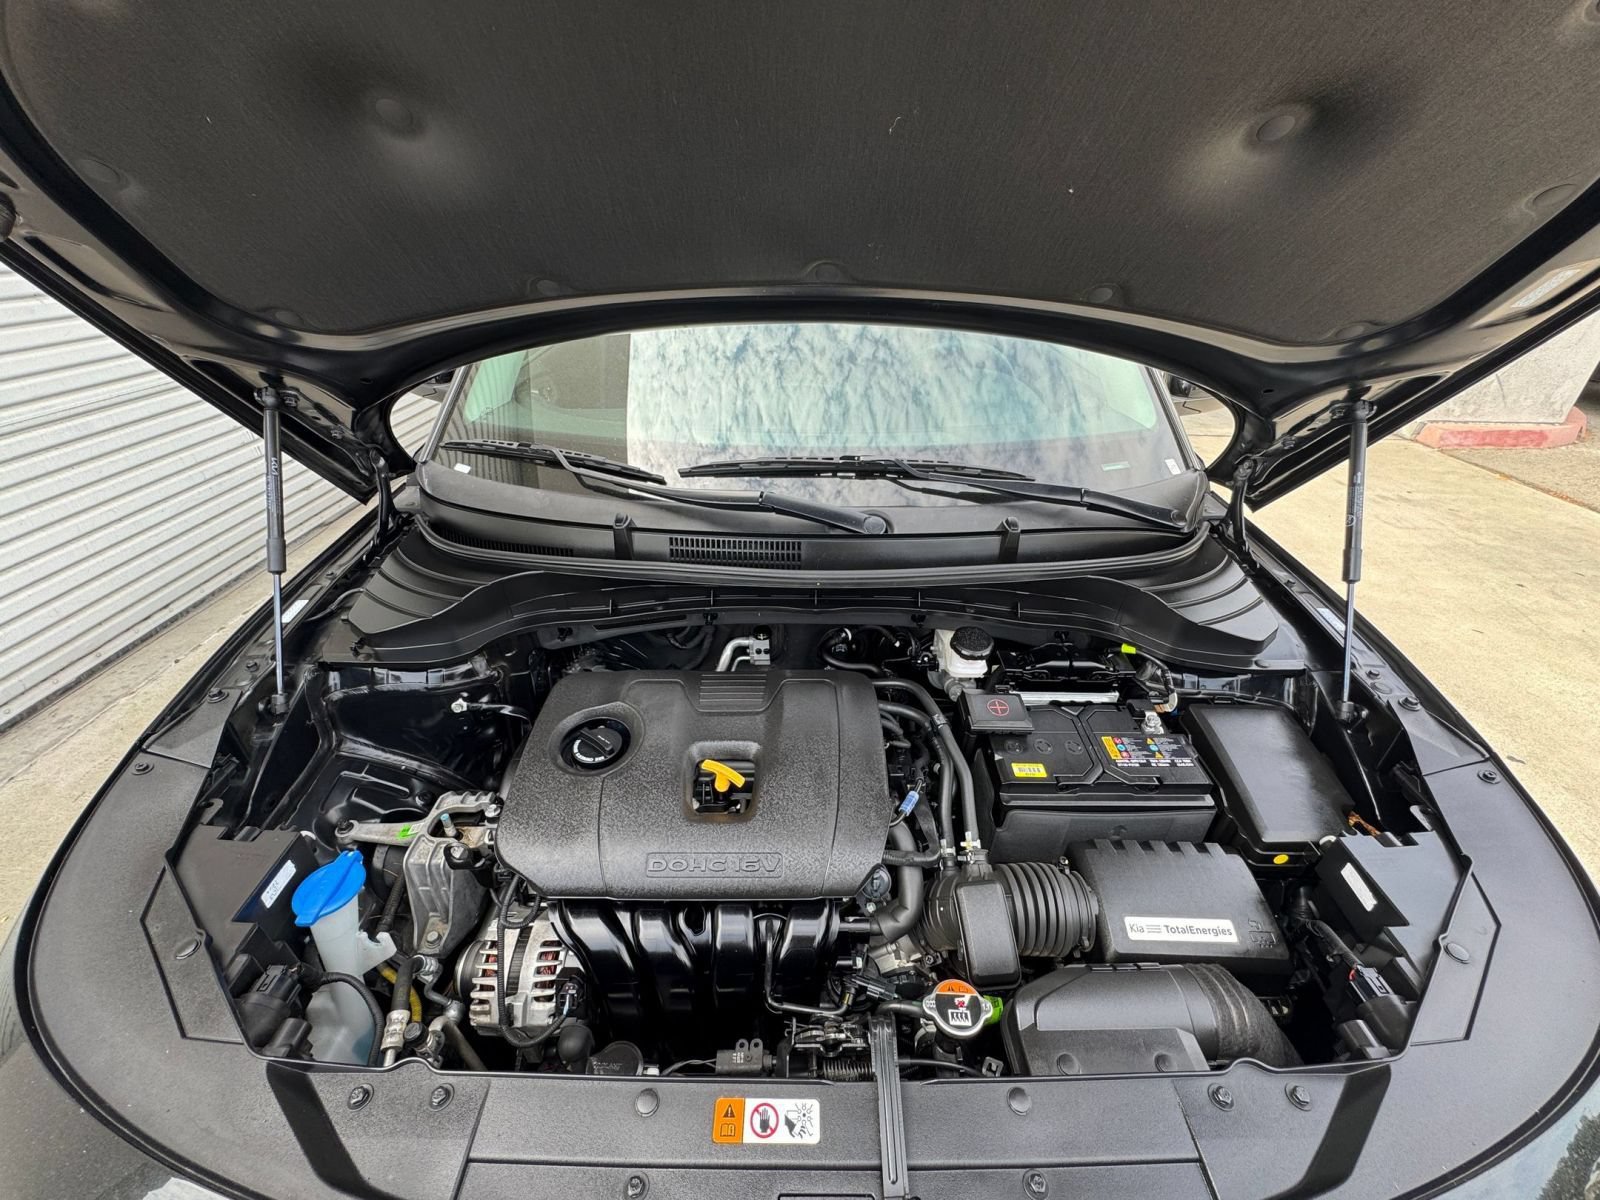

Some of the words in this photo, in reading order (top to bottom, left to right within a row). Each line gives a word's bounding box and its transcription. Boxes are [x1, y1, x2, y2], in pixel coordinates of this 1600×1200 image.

[648, 858, 727, 872] DOHC
[735, 856, 781, 872] 16V
[1130, 923, 1145, 934] Kia
[1164, 925, 1233, 937] TotalEnergies
